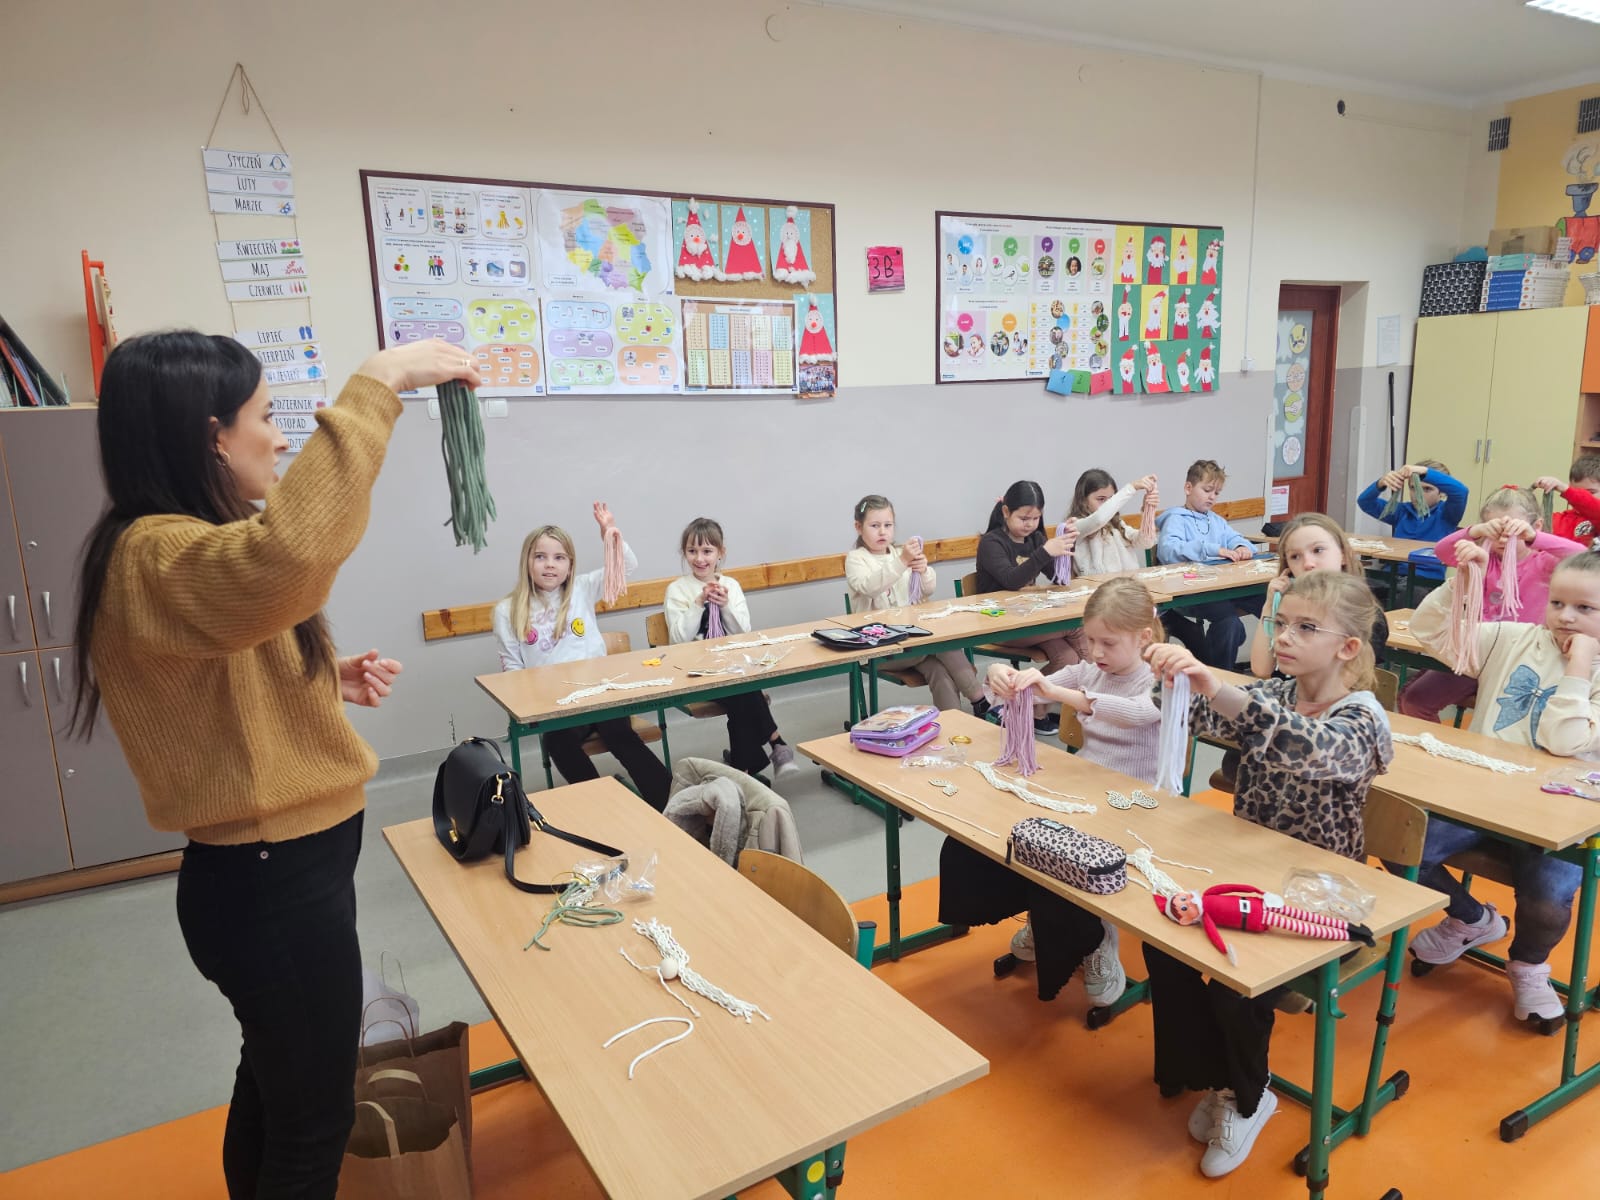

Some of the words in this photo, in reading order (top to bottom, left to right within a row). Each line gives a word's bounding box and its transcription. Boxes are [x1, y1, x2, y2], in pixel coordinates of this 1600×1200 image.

[227, 153, 262, 169] STYCZEŃ
[236, 176, 256, 191] LUTY
[234, 198, 263, 212] MARZEC
[235, 240, 278, 256] KWIECIEŃ
[251, 262, 270, 277] MAJ
[248, 284, 284, 297] CZERWIEC
[257, 330, 283, 343] LIPIEC
[274, 416, 306, 430] ISTOPAD
